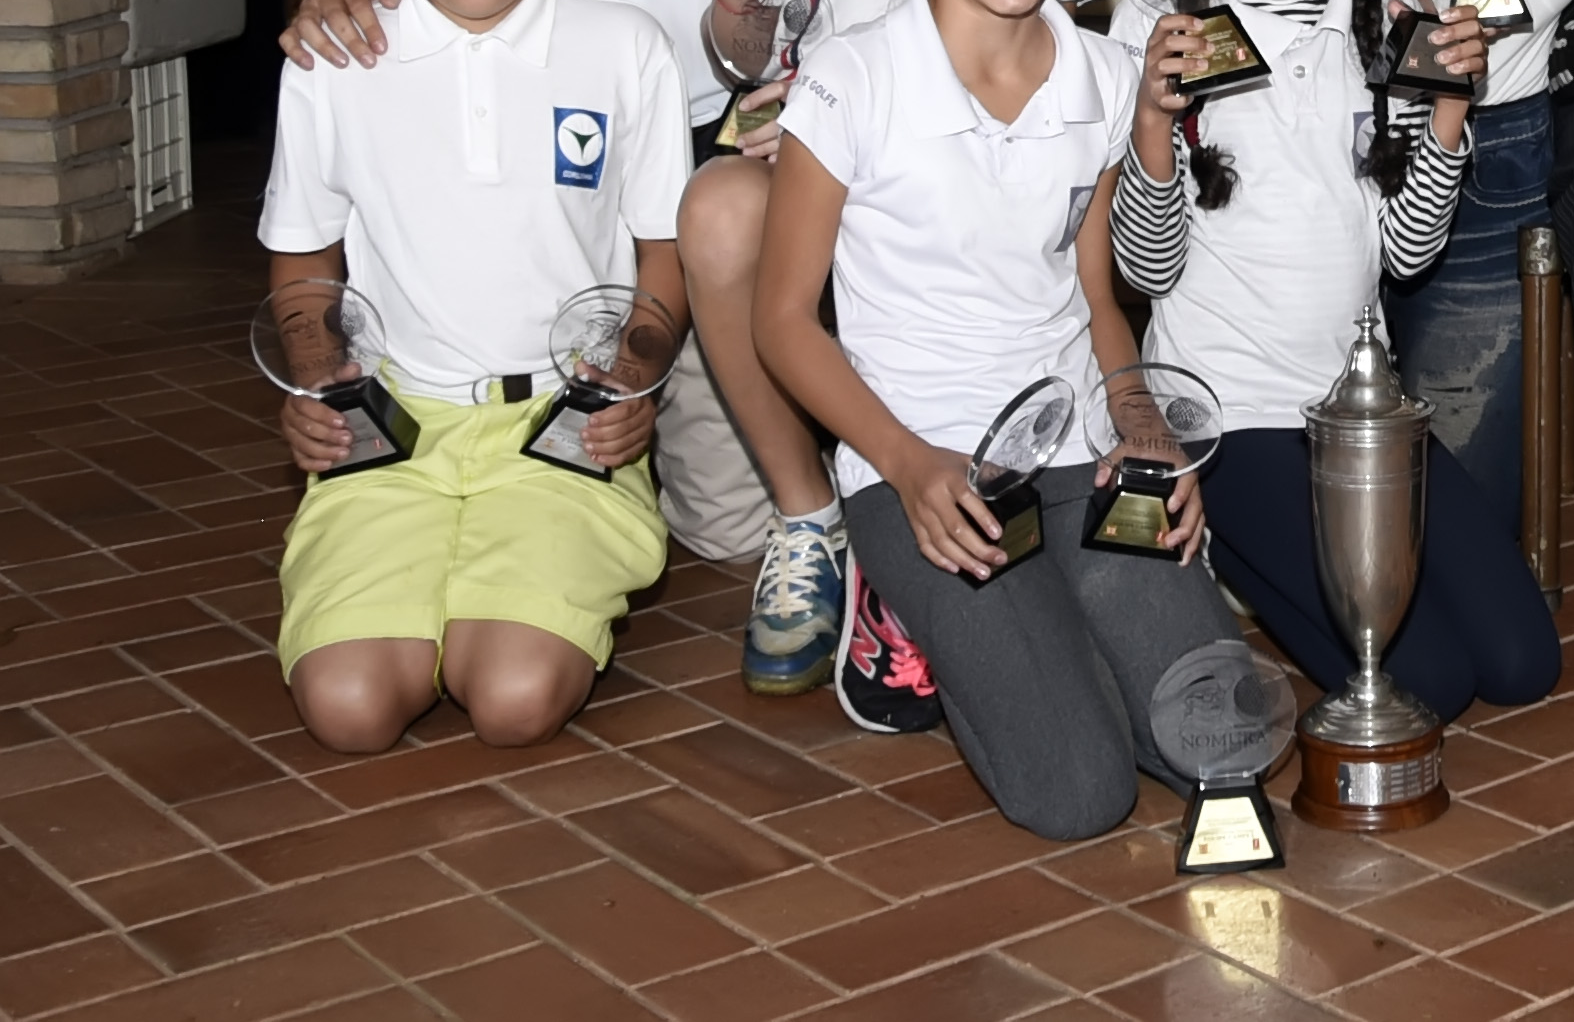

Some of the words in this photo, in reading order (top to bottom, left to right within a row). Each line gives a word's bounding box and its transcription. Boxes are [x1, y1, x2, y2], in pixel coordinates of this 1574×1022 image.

[1127, 44, 1145, 59] GOL
[809, 79, 839, 109] GOLFE
[1182, 730, 1268, 750] NOMURA
